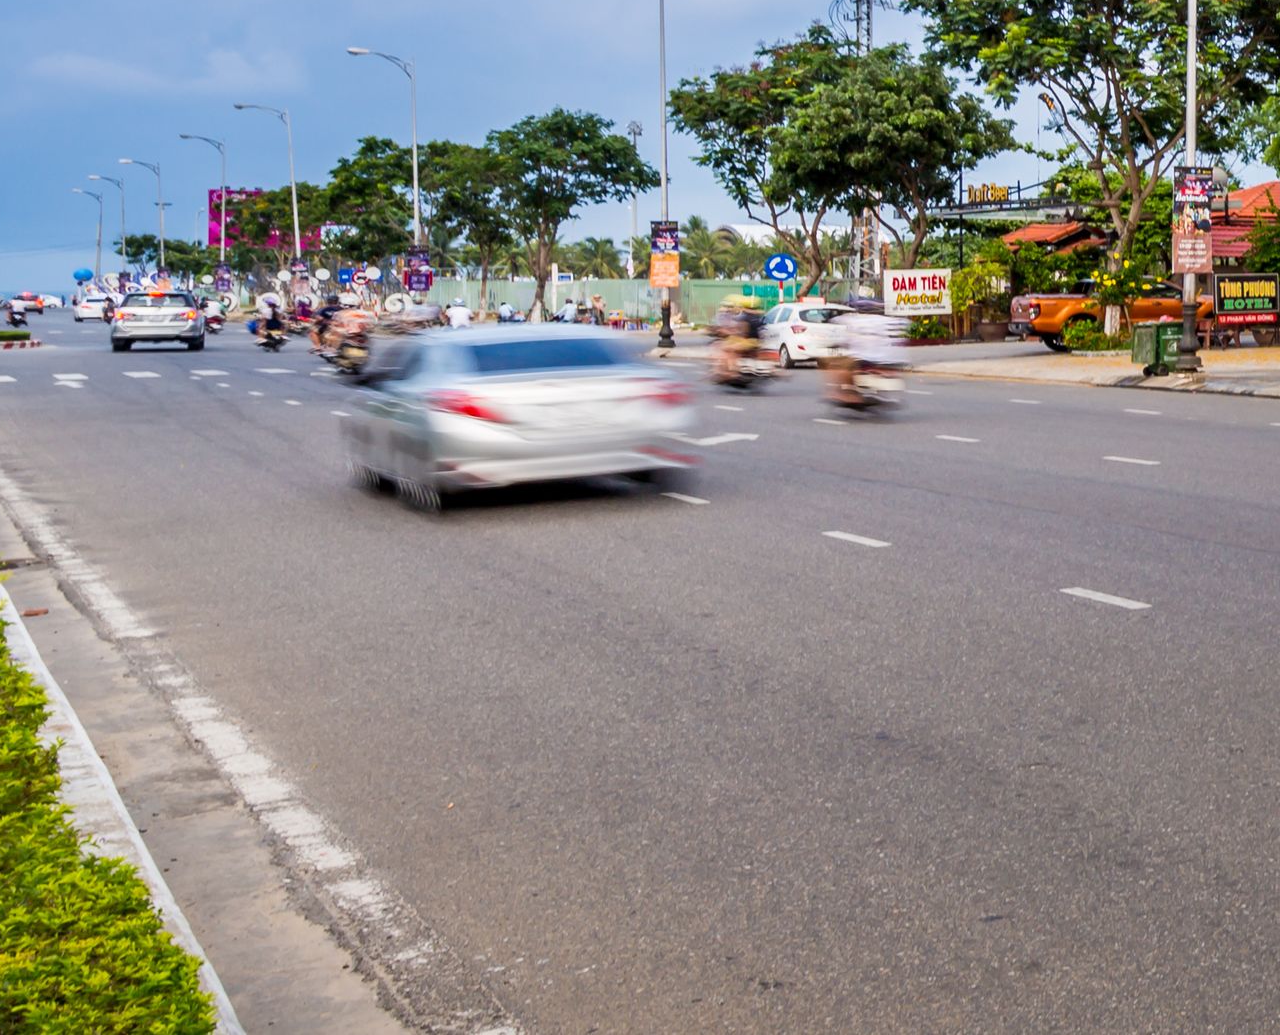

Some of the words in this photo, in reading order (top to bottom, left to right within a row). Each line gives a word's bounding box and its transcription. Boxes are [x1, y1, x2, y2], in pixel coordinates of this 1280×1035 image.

[968, 184, 990, 202] Draft
[990, 182, 1008, 202] Beer
[1220, 278, 1242, 298] TÙNG
[896, 292, 943, 305] Hotel
[1224, 298, 1272, 310] HOTEL
